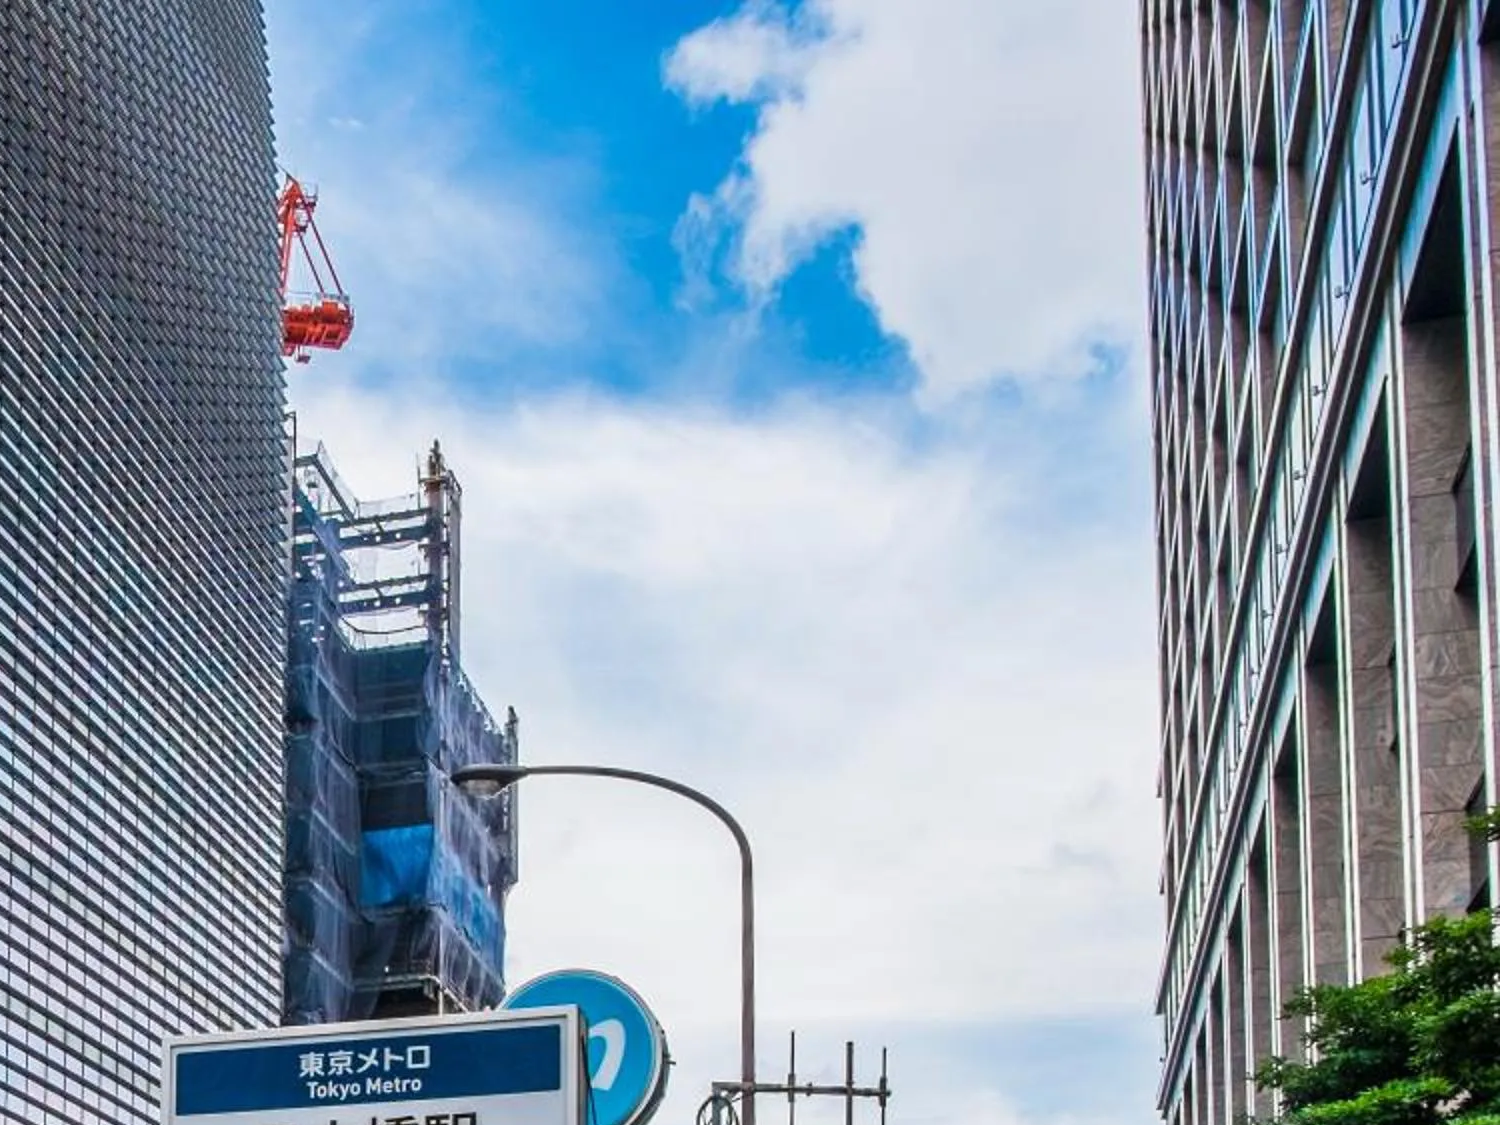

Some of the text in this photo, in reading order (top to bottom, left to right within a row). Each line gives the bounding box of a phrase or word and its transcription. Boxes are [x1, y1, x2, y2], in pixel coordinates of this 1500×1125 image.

[299, 1046, 431, 1078] 東京メトロ
[306, 1077, 422, 1101] Tokyo Metro
